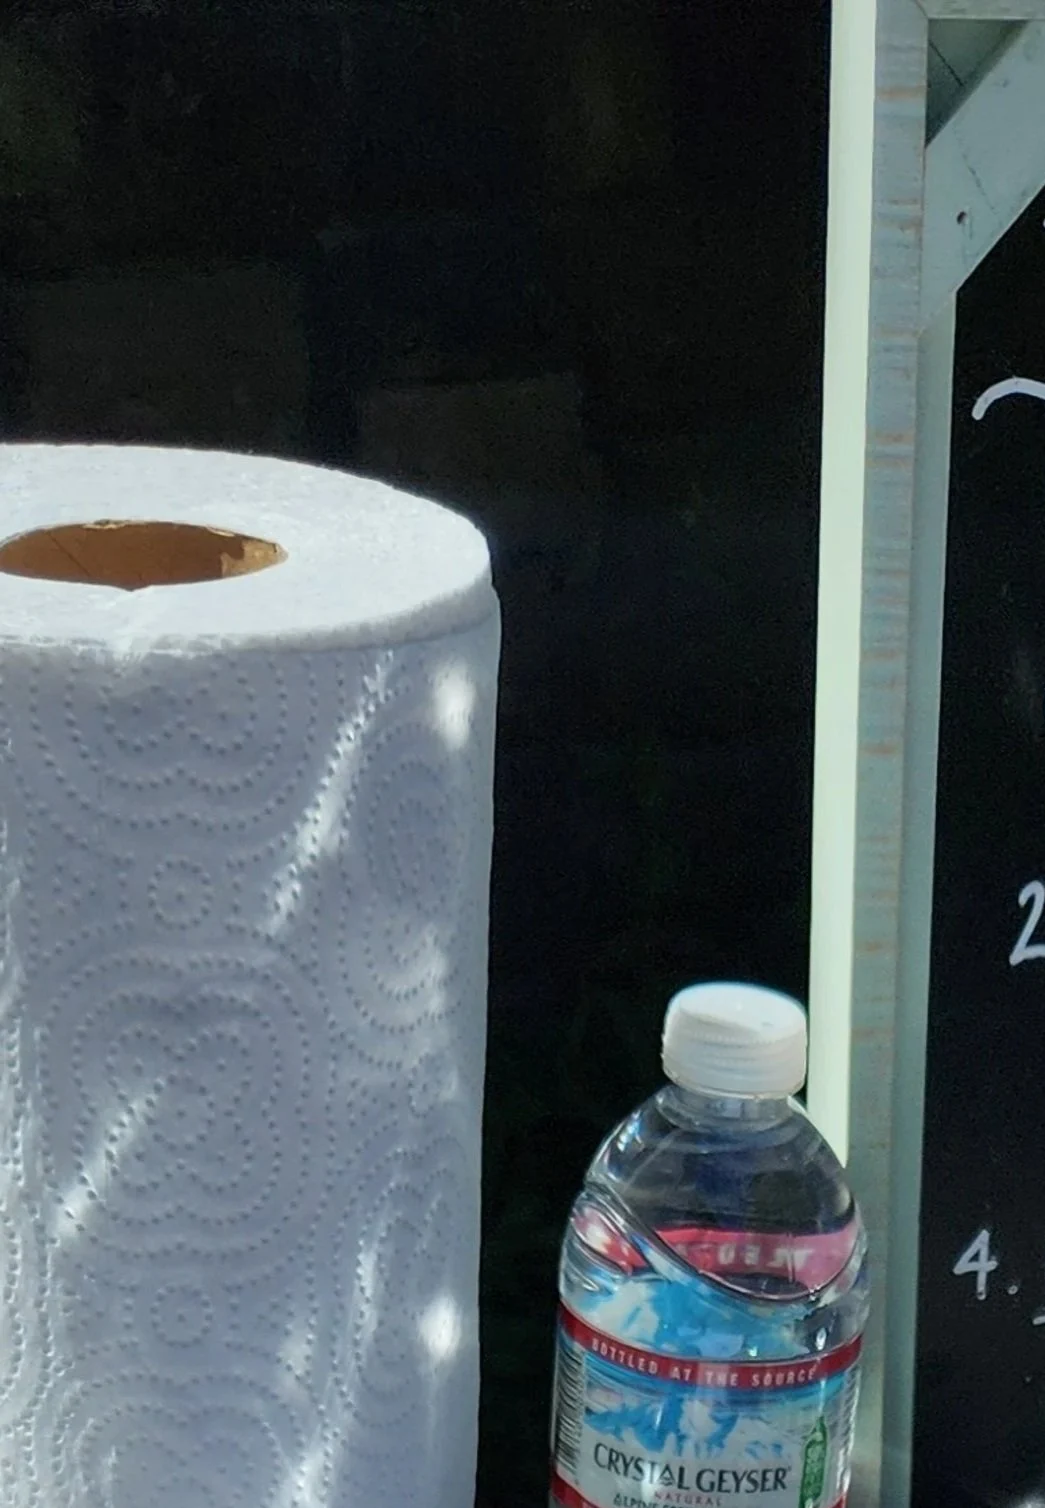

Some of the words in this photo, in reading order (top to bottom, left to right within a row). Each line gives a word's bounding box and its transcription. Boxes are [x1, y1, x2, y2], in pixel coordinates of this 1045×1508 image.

[953, 1229, 1019, 1301] 4.
[591, 1337, 659, 1375] BOTTLED
[669, 1365, 691, 1382] AT
[704, 1369, 739, 1387] THE
[751, 1365, 816, 1388] SOURCE
[593, 1442, 691, 1491] CRYSTAL
[654, 1491, 722, 1507] NATURAL
